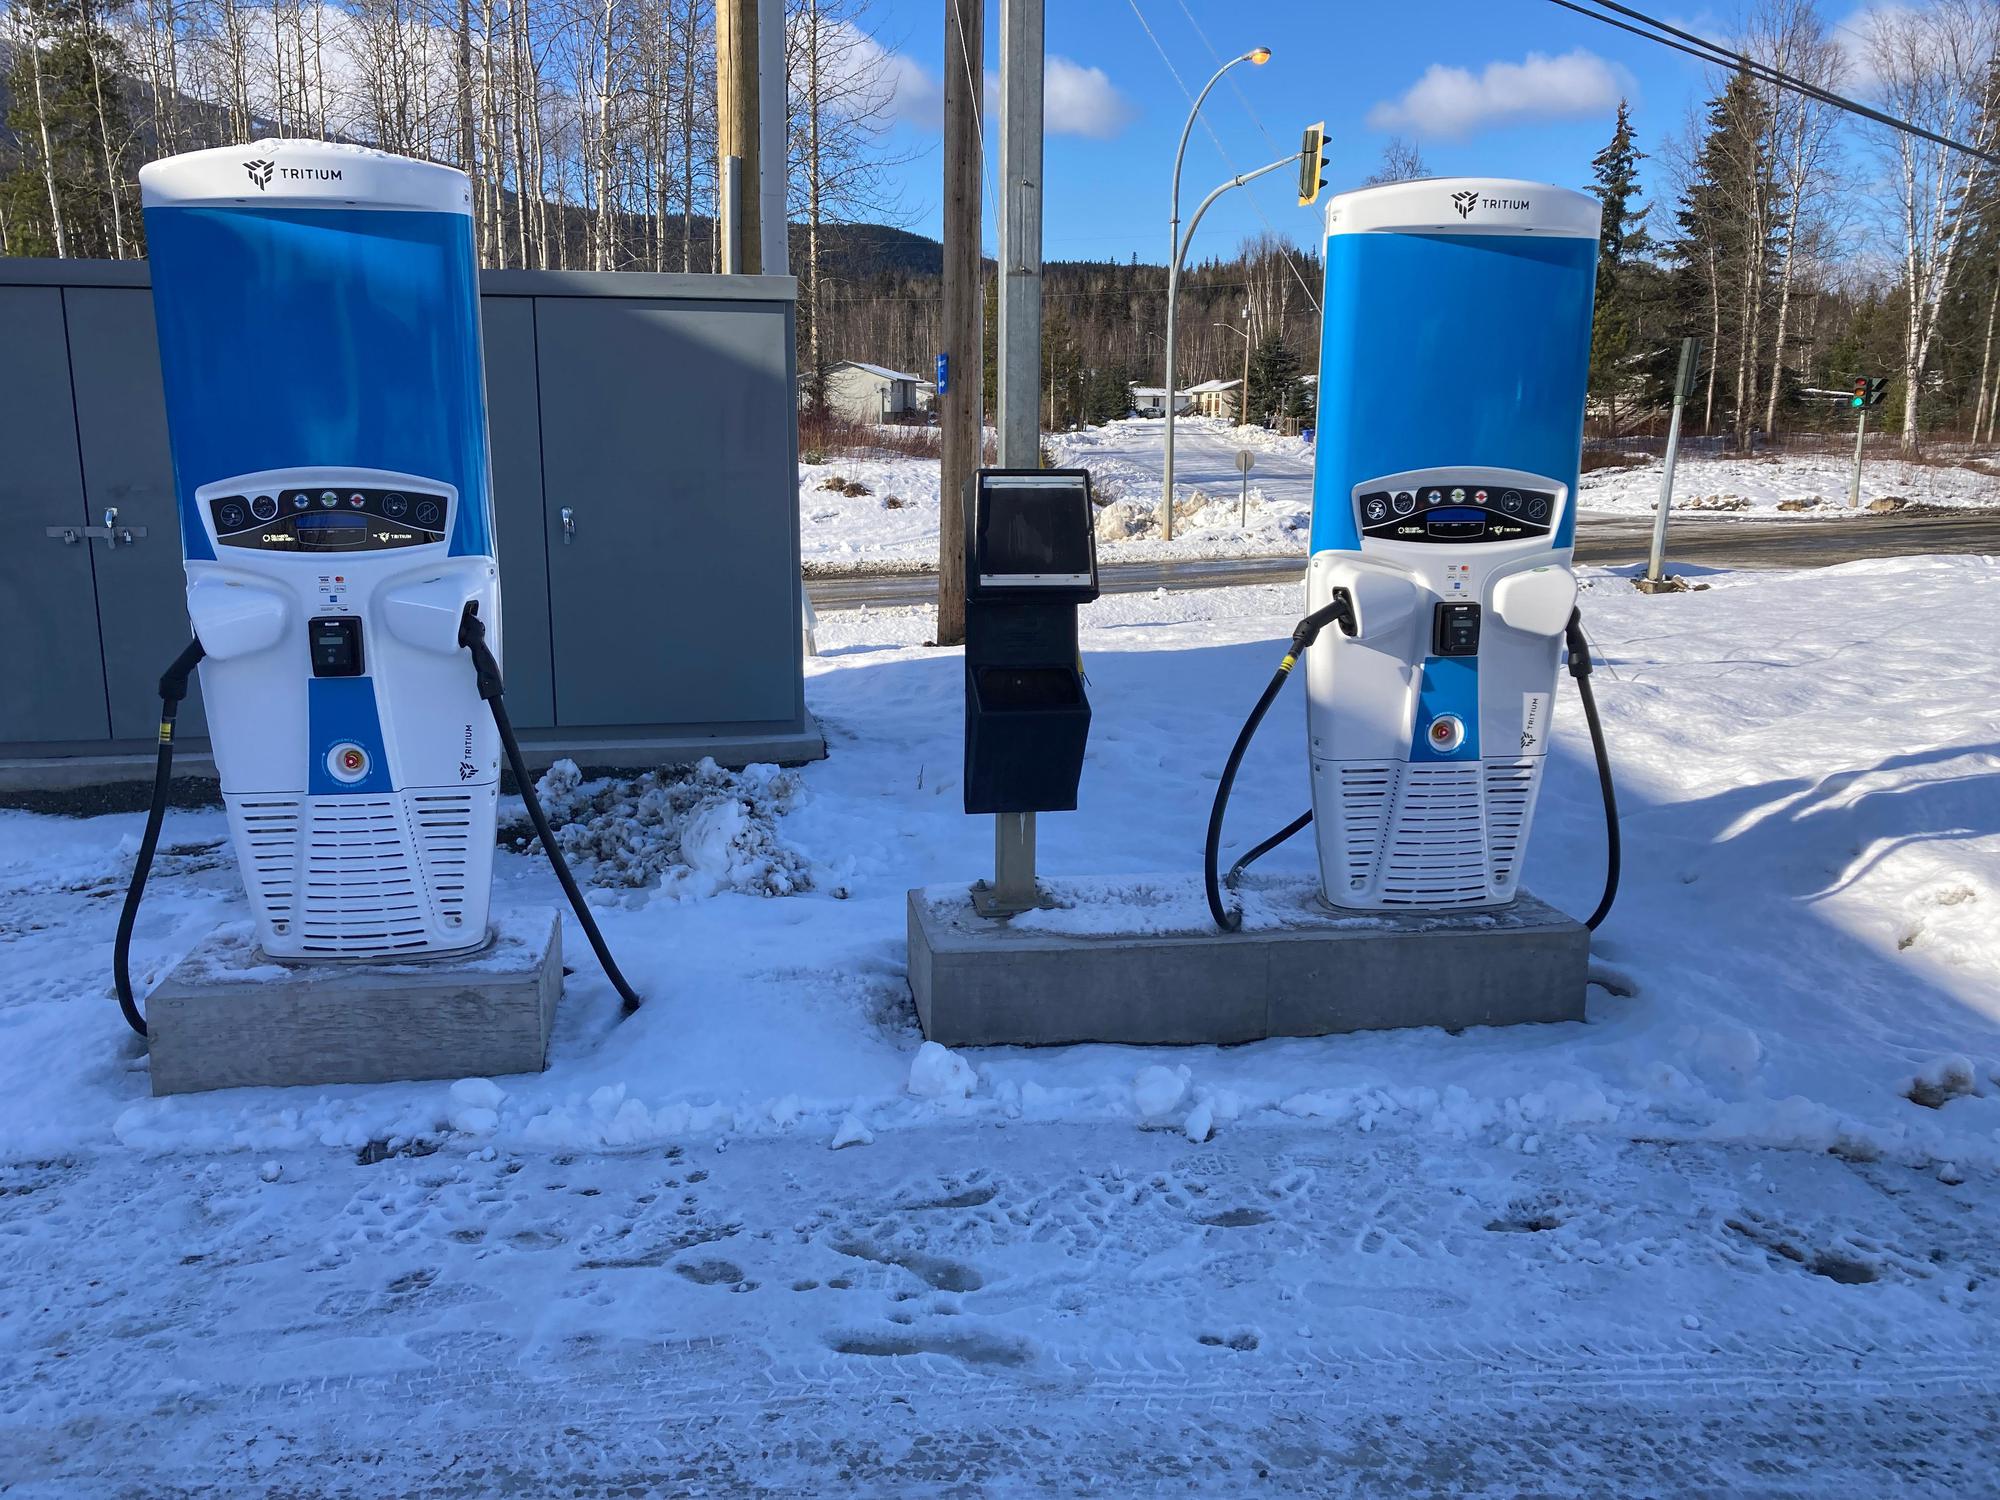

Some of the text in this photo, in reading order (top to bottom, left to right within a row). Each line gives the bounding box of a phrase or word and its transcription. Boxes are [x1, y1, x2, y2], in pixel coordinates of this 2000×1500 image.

[280, 168, 343, 181] TRITIUM
[1482, 199, 1530, 210] TRITIUM
[1527, 698, 1539, 730] TRITIUM
[464, 724, 472, 760] TRITIUM
